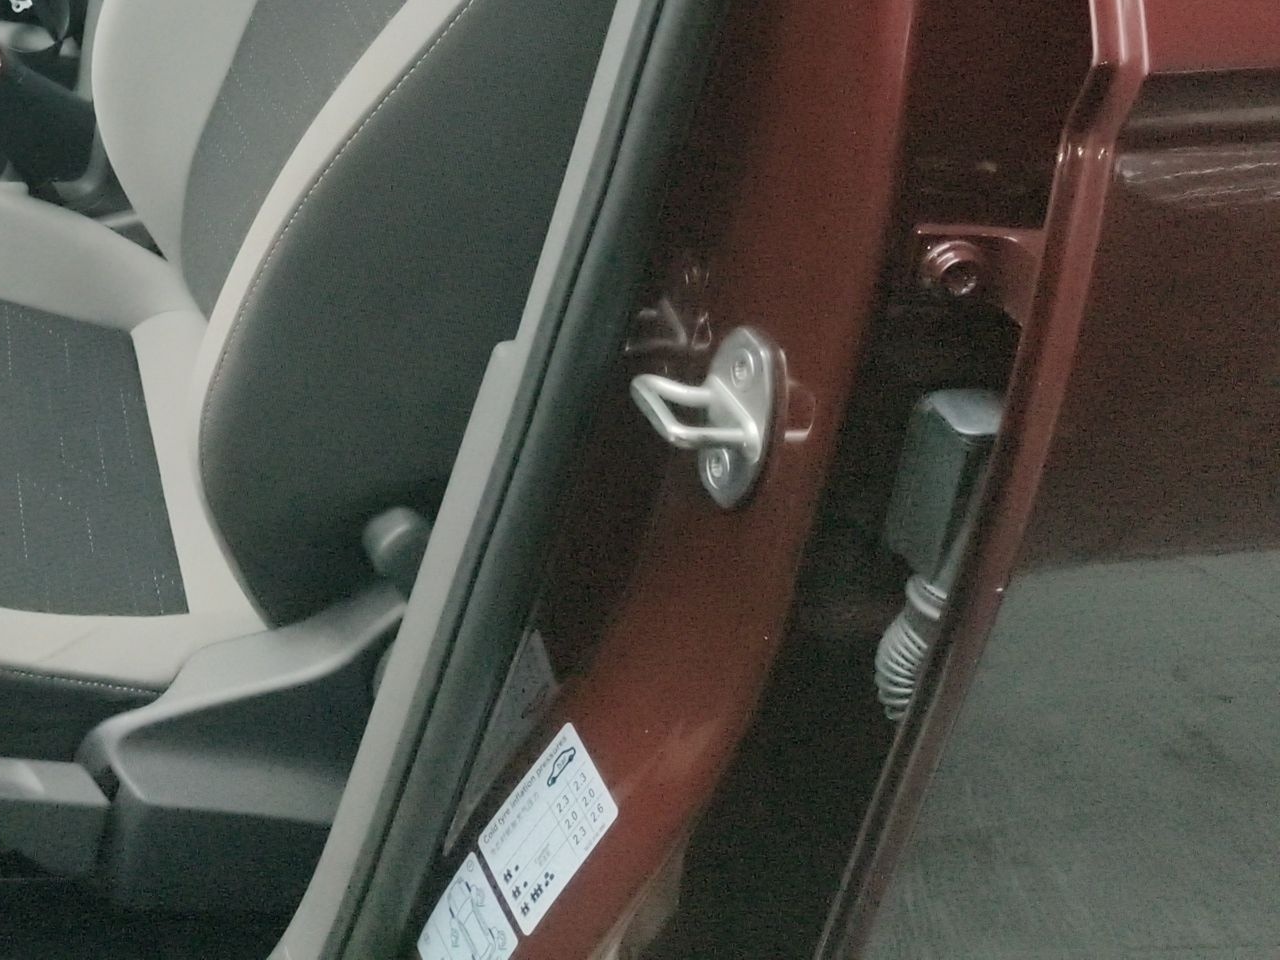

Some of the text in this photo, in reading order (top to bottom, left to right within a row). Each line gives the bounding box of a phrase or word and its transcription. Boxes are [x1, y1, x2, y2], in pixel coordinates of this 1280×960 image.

[483, 823, 499, 844] Cold
[499, 808, 511, 825] tyre
[510, 775, 536, 807] inflation
[556, 772, 587, 813] 2.3 2.3
[565, 788, 595, 829] 2.0 2.0
[573, 826, 586, 845] 2.3
[590, 803, 604, 822] 2.6
